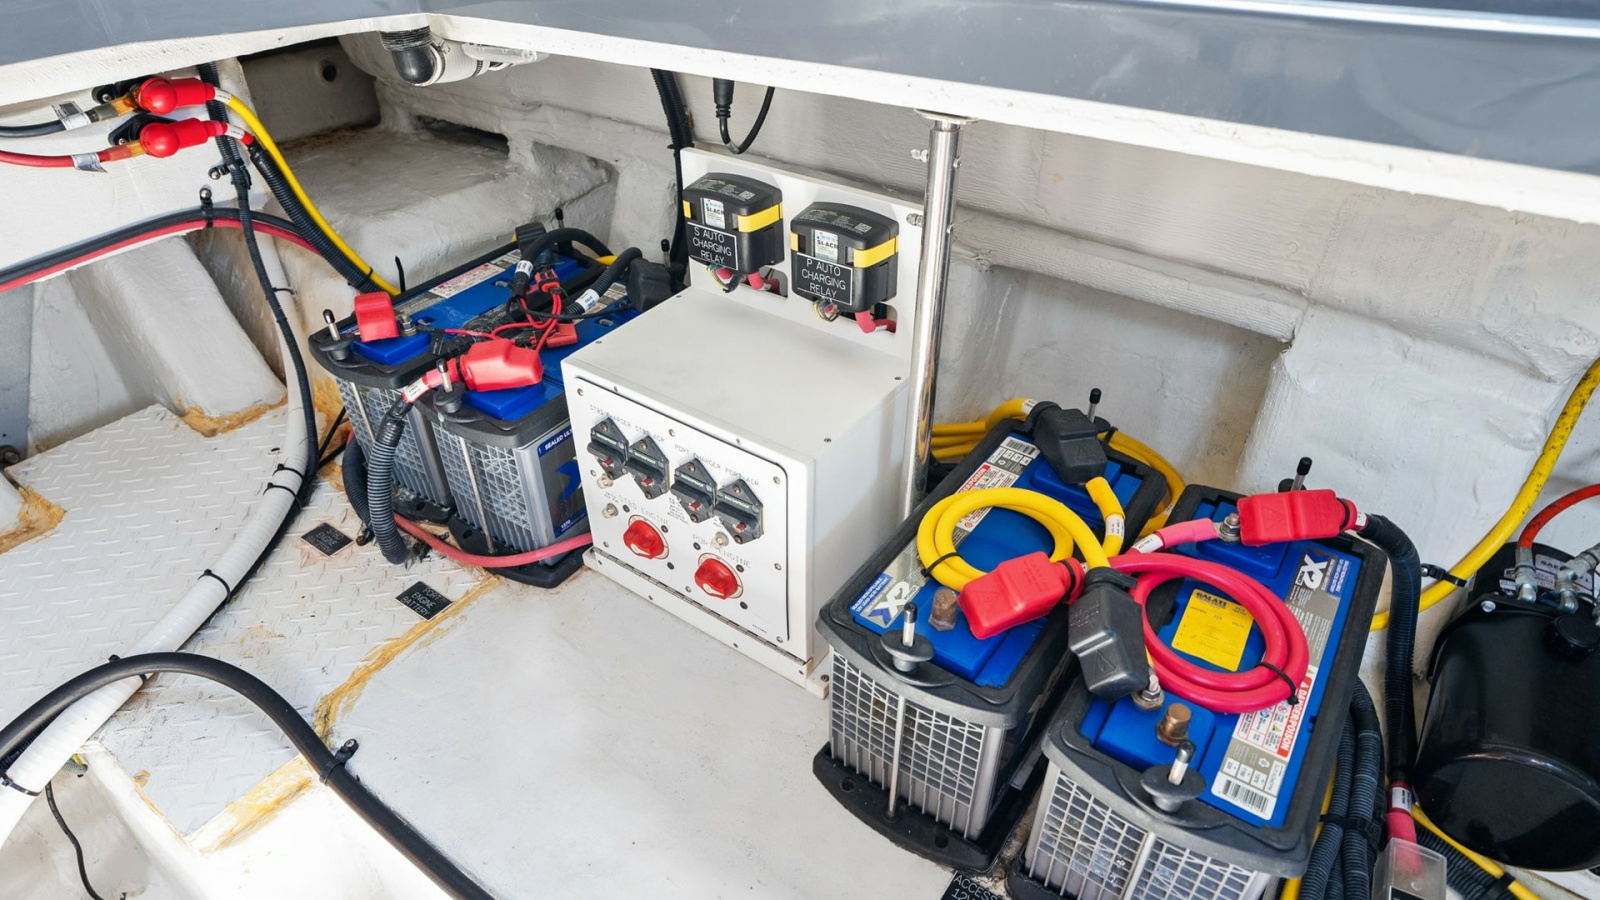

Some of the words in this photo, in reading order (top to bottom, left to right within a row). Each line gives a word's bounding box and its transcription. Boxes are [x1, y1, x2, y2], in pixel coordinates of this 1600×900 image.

[694, 226, 700, 236] S
[702, 229, 724, 243] AUTO
[692, 237, 732, 256] CHARGING
[700, 250, 724, 264] RELAY
[806, 258, 813, 267] P
[816, 262, 841, 276] AUTO
[801, 268, 846, 290] CHARGING
[809, 282, 837, 298] RELAY
[545, 434, 564, 450] SEALED
[641, 508, 671, 528] ENGINE
[316, 531, 338, 546] ENGINE
[719, 548, 752, 568] ENGINE
[1301, 554, 1328, 590] X2
[411, 592, 436, 609] ENGINE
[422, 587, 441, 600] PORT
[873, 581, 909, 620] X2
[400, 595, 430, 616] BATTERY
